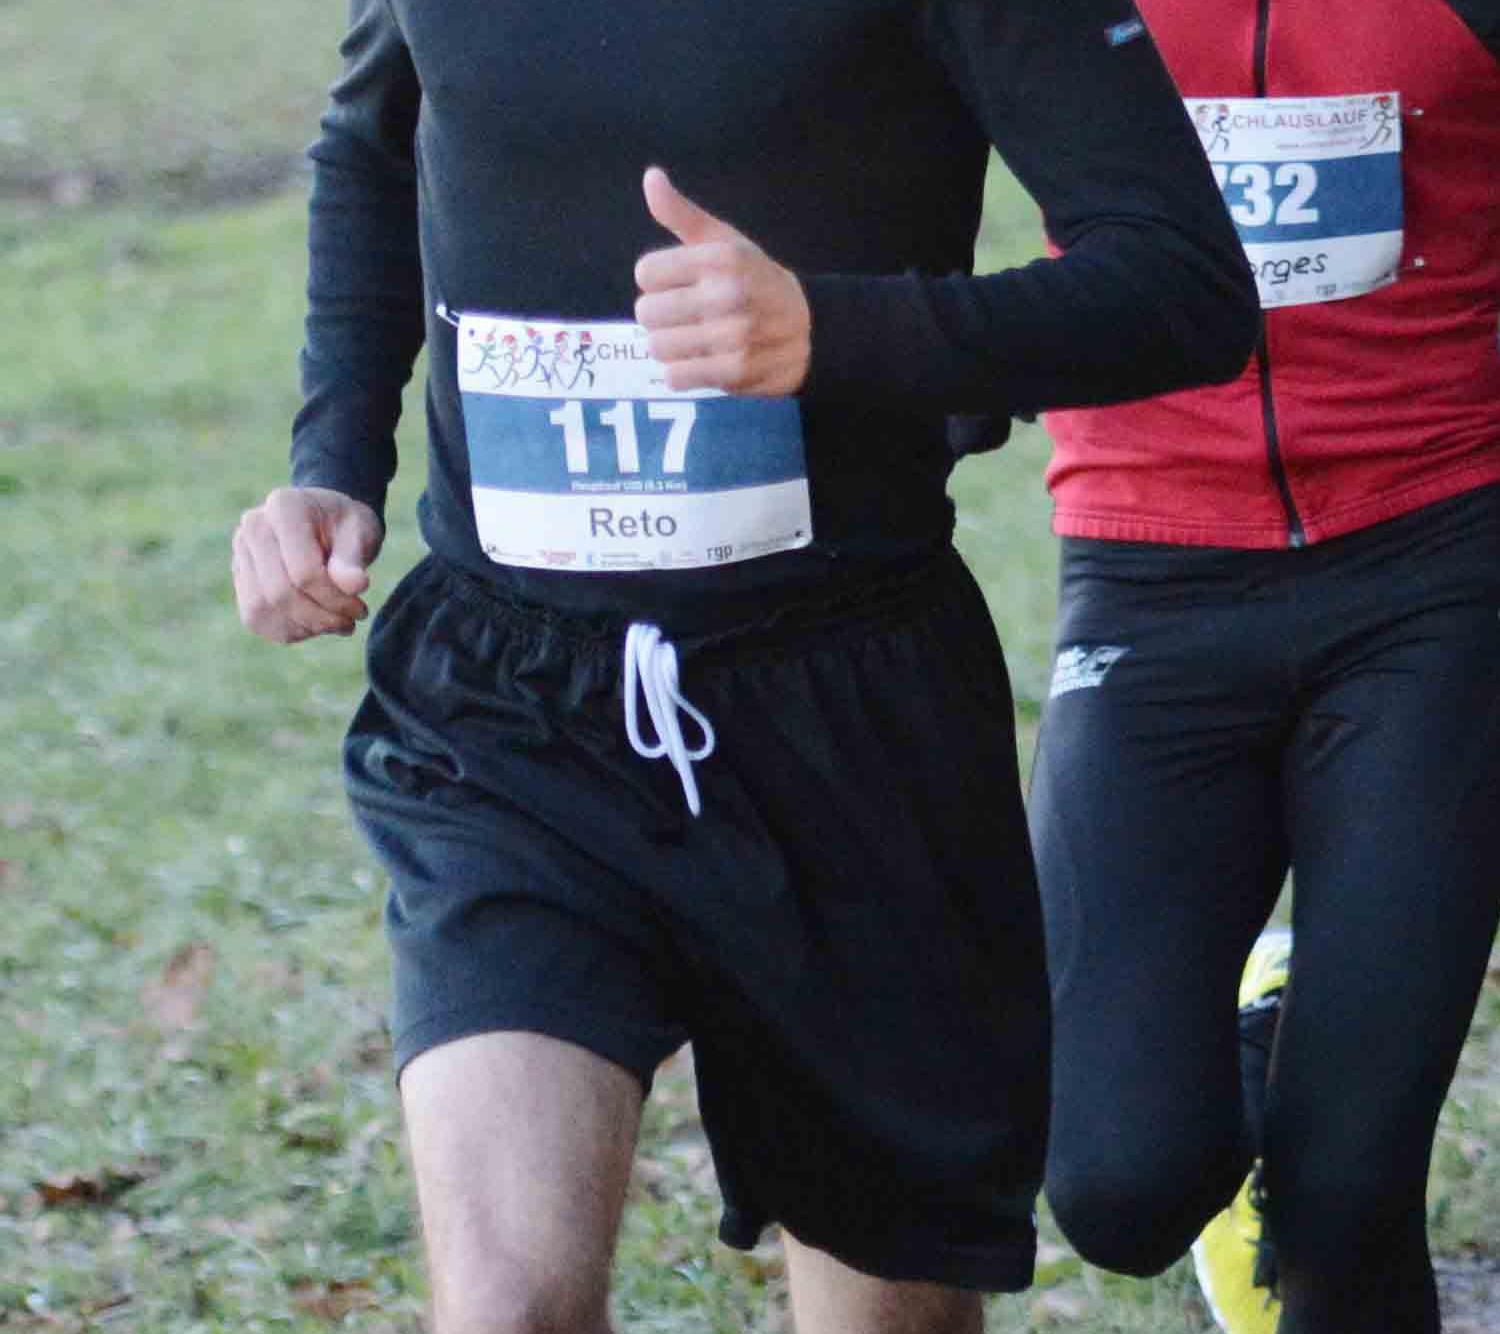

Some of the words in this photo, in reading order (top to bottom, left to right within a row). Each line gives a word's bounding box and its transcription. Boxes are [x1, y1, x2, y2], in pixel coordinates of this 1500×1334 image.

[1232, 109, 1369, 130] CHLAUSLAUF
[594, 342, 650, 361] CHL
[549, 400, 697, 474] 117
[590, 508, 678, 538] Reto
[706, 543, 734, 561] rgp
